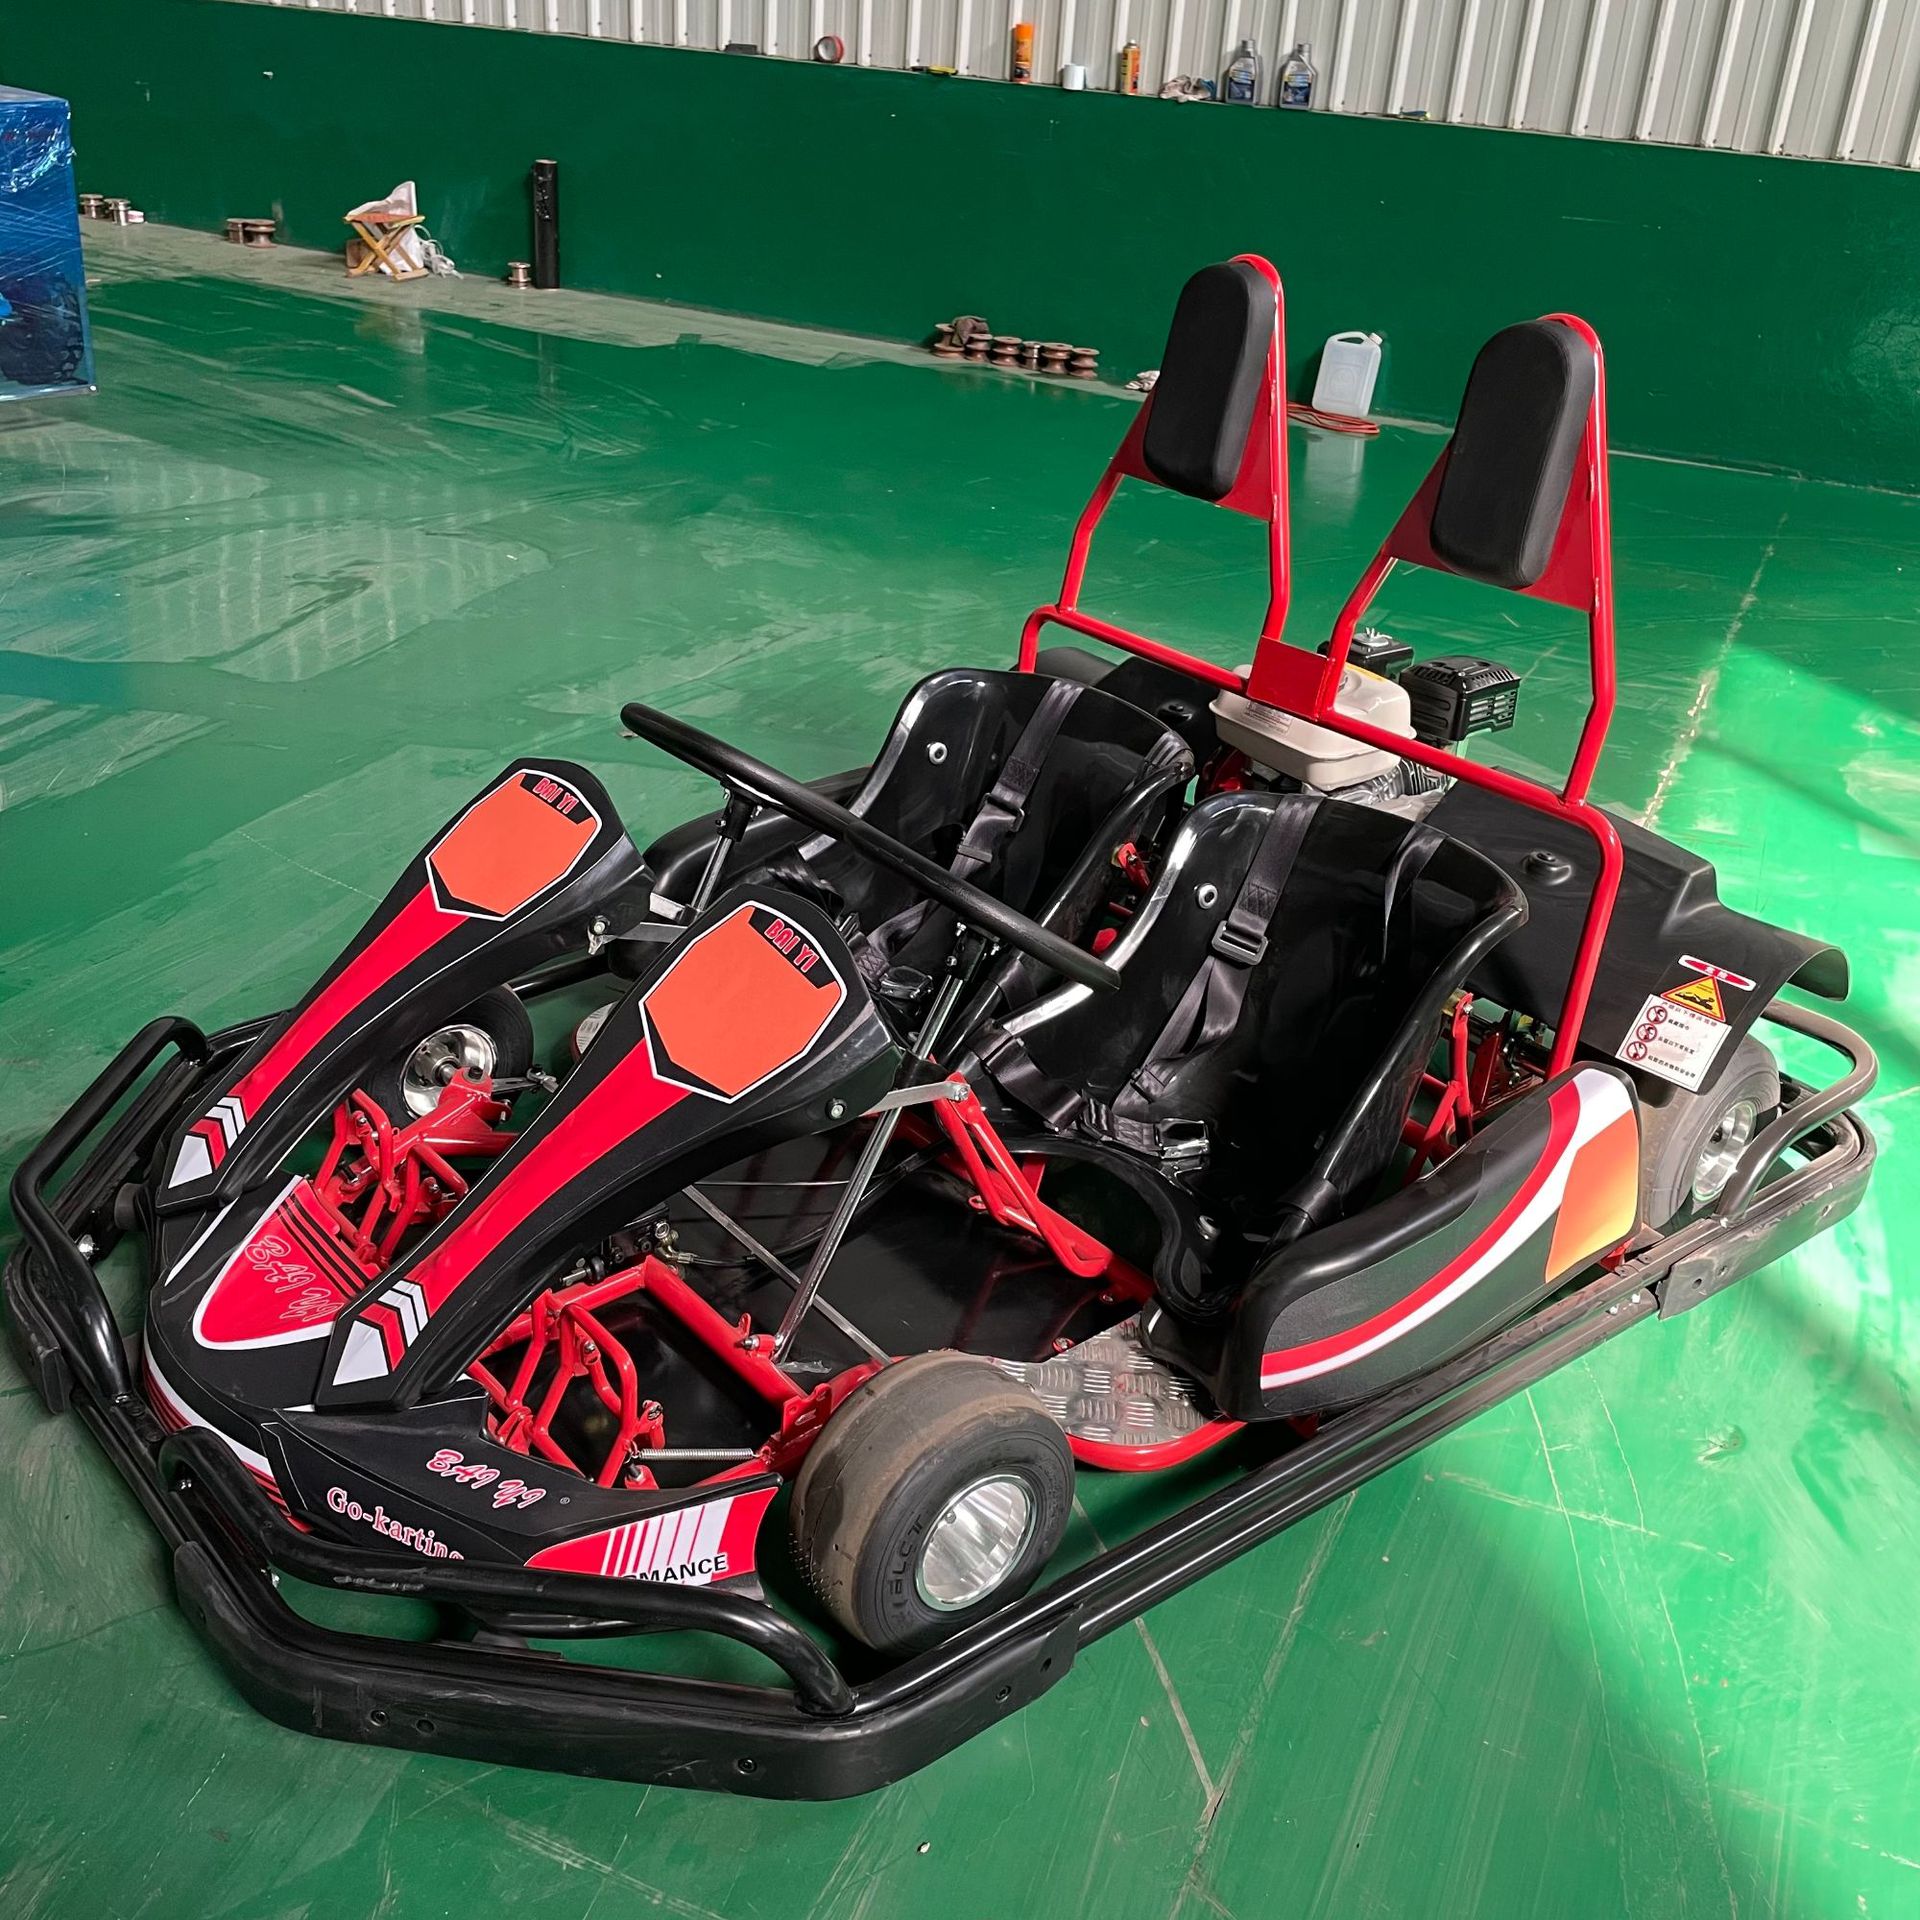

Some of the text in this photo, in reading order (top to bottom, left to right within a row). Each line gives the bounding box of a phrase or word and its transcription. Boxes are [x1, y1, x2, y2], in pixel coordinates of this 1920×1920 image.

[557, 792, 579, 814] YI
[764, 919, 819, 972] BAI YI
[623, 1554, 727, 1582] MANCE
